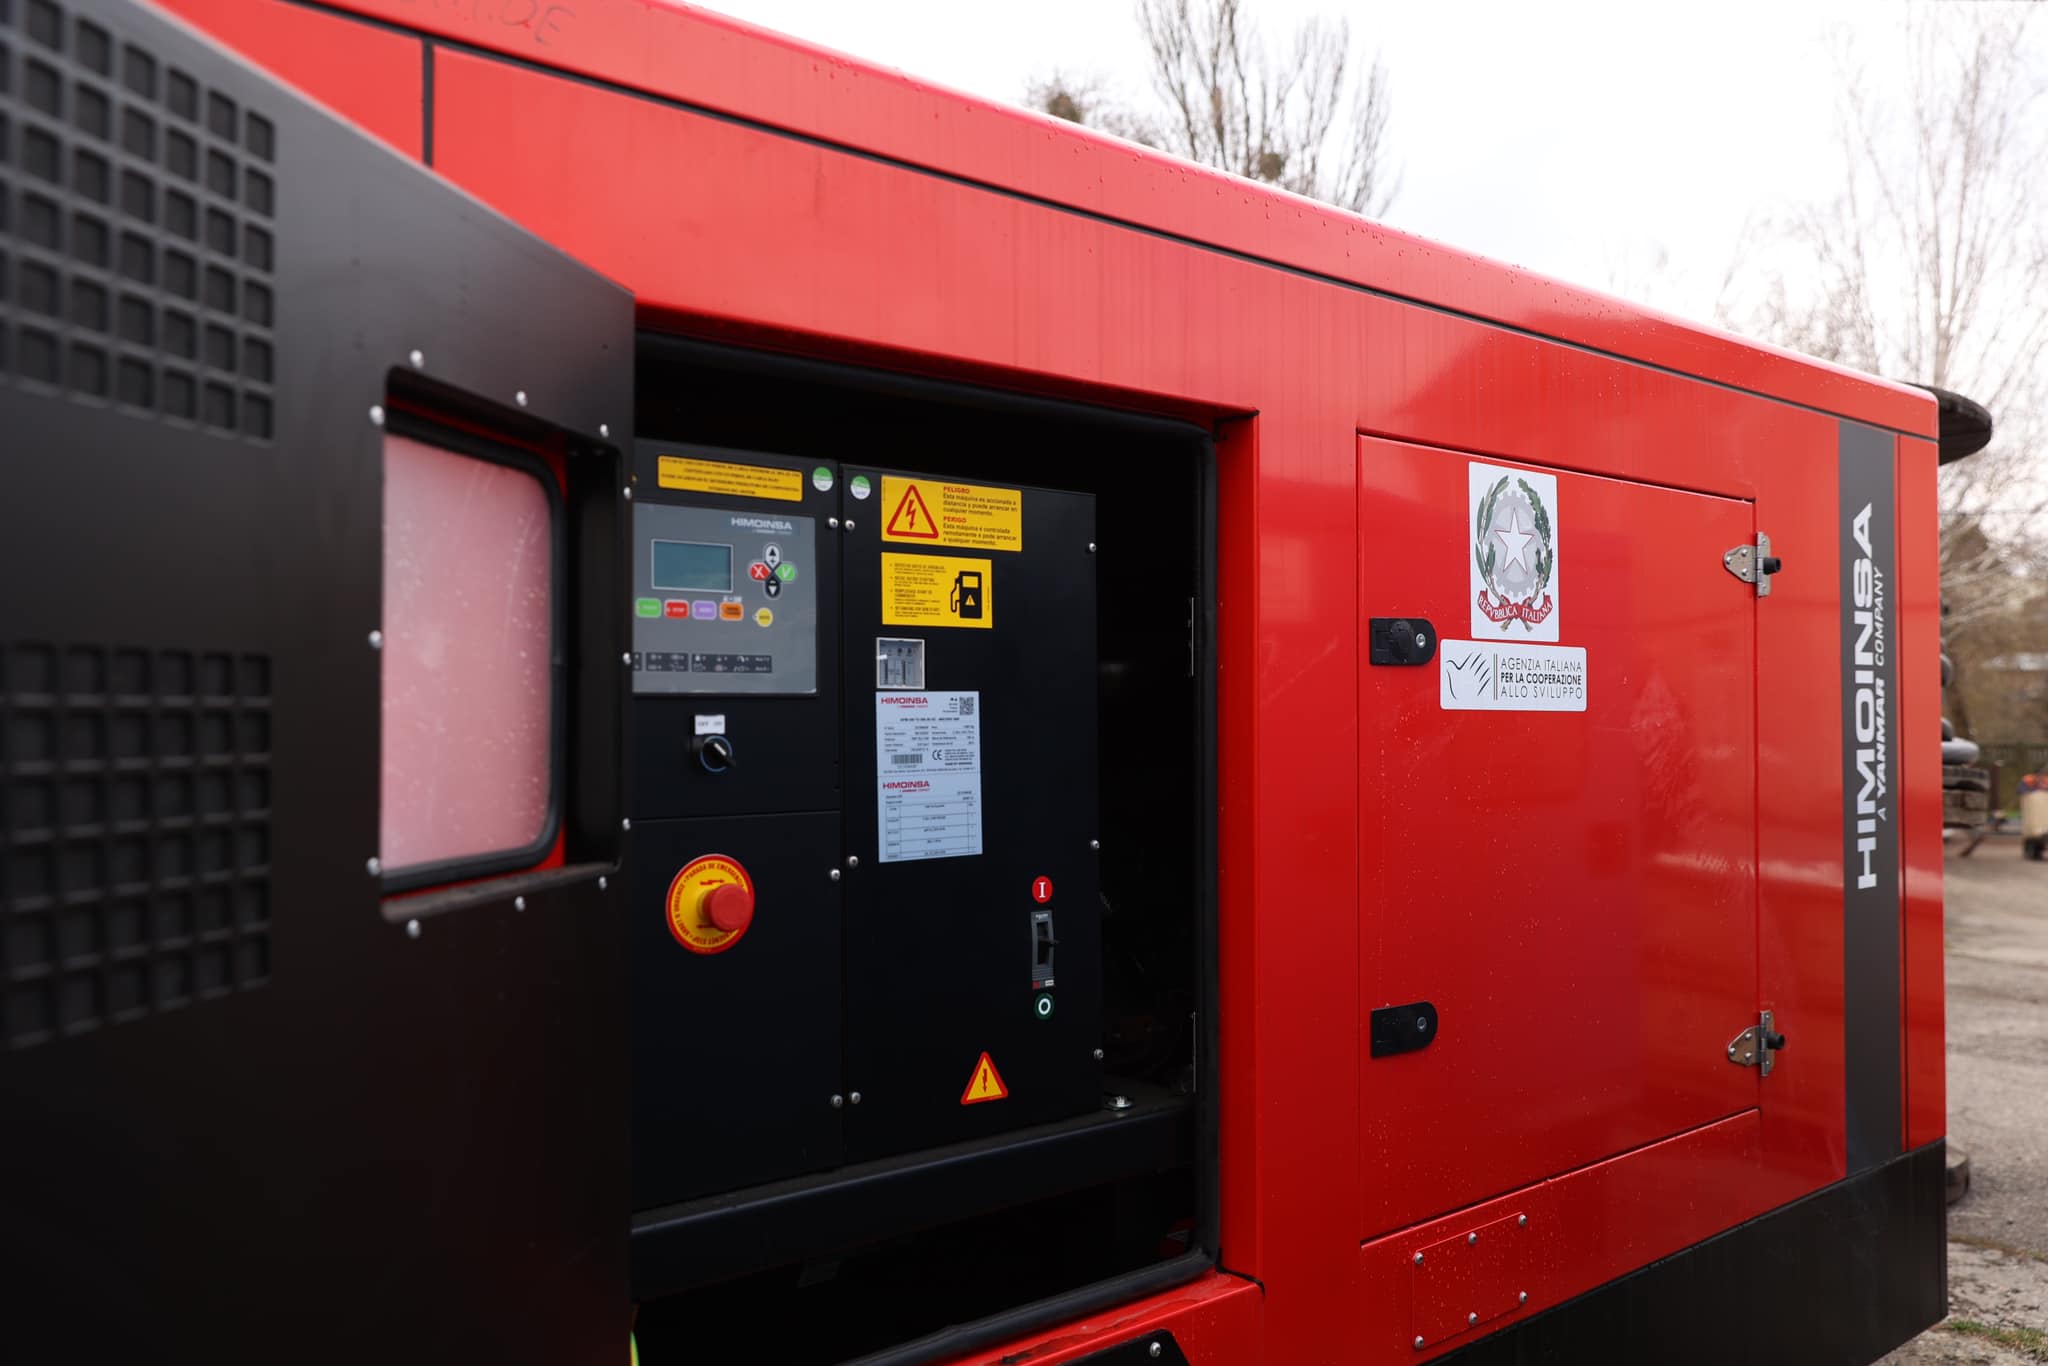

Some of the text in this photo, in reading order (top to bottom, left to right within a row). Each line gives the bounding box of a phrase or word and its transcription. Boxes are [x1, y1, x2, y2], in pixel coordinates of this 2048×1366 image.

[731, 517, 792, 530] HIMOINSA
[1478, 595, 1552, 622] REPVBBLICA ITALIANA
[1501, 658, 1582, 672] AGENZIA ITALIANA
[1501, 672, 1582, 685] PER LA COOPERAZIONE
[1501, 686, 1582, 699] ALLO SVILUPPO
[1852, 502, 1877, 889] HIMOINSA
[1873, 566, 1887, 820] A YANMAR COMPANY
[882, 780, 930, 790] HIMOINSA
